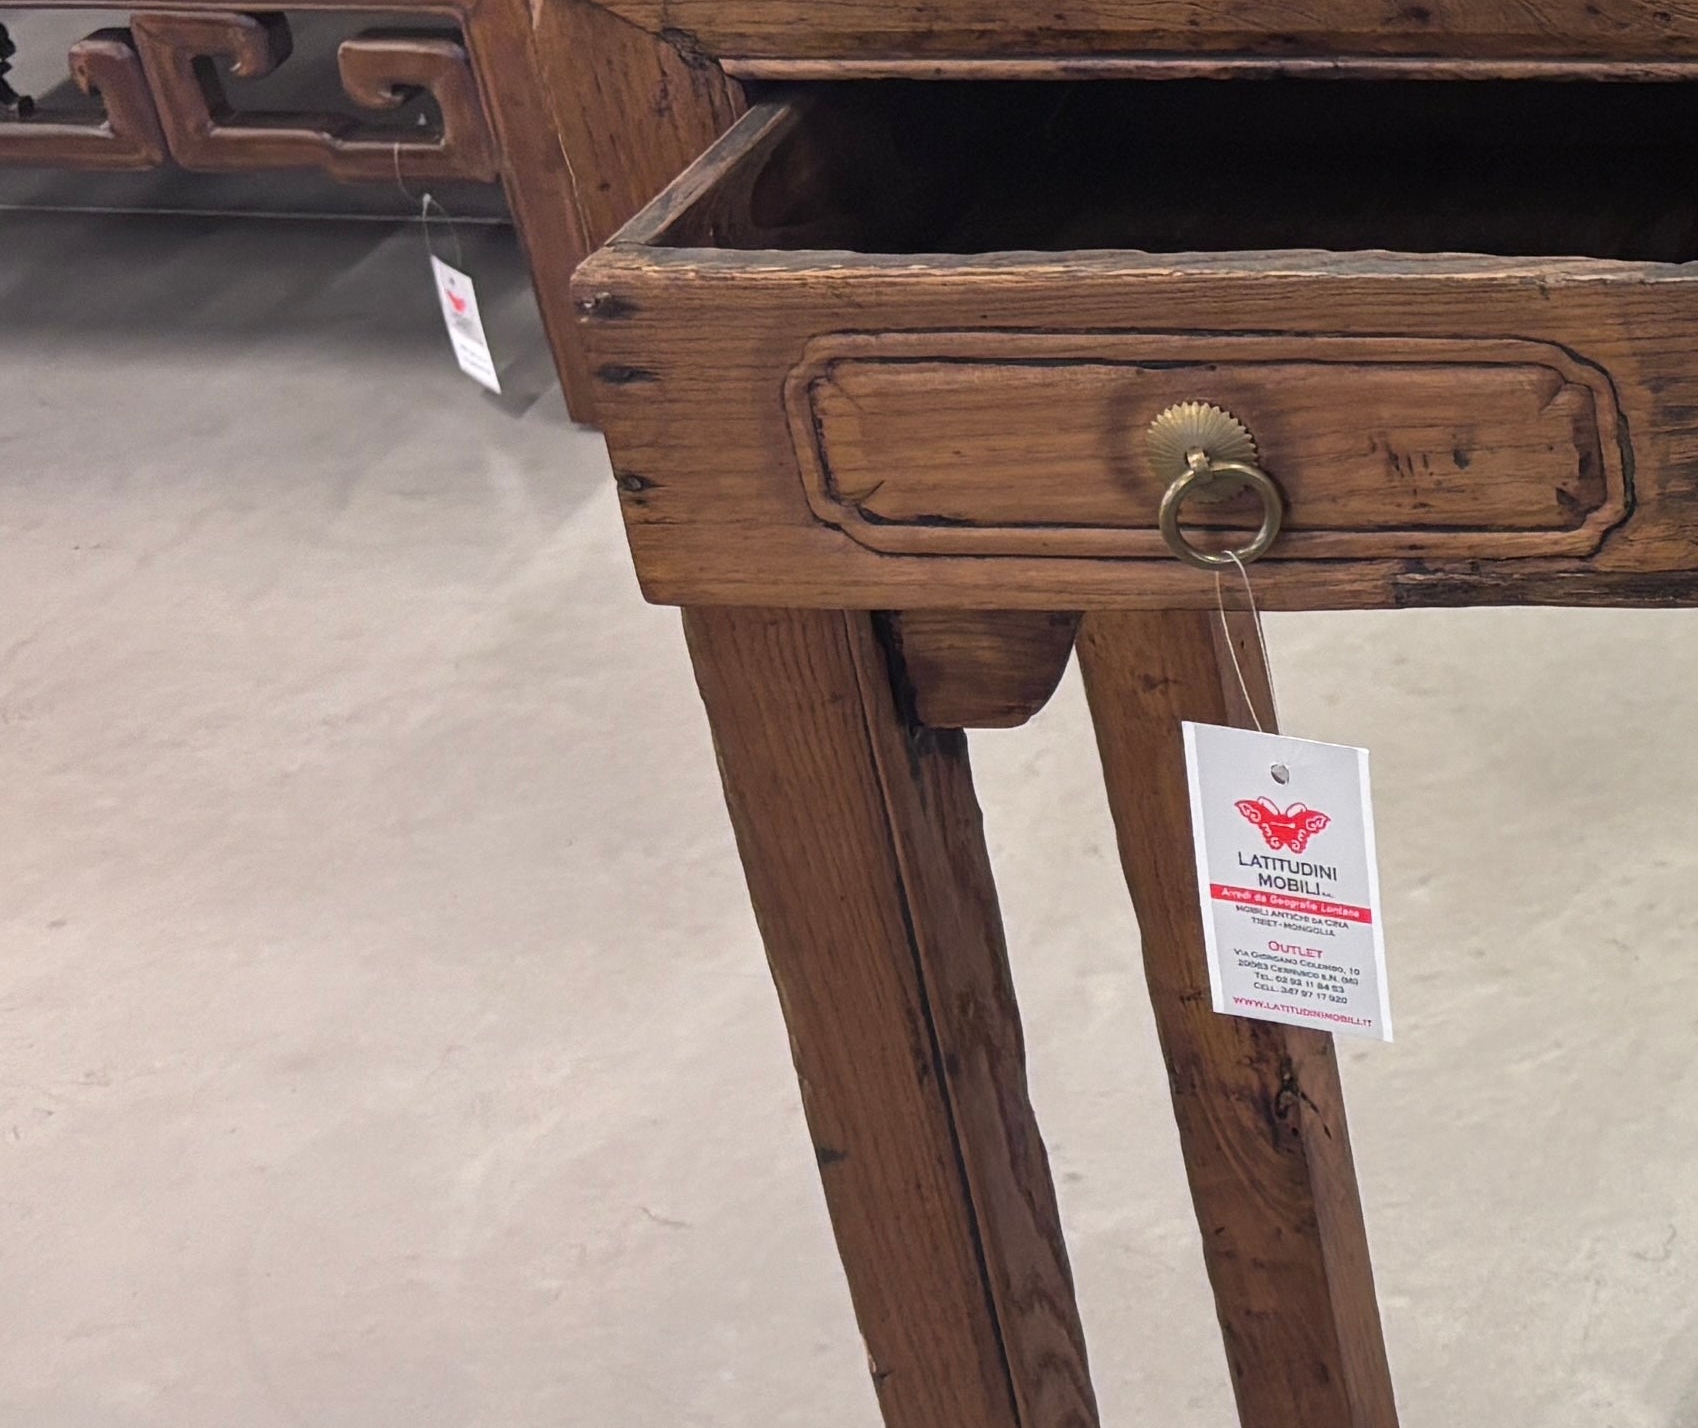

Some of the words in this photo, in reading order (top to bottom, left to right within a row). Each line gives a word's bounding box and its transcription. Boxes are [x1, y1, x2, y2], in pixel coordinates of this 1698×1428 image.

[1238, 851, 1337, 881] LATITUDINI
[1258, 873, 1320, 896] MOBILI
[1270, 910, 1310, 923] ANTICHI
[1311, 917, 1324, 926] DA
[1324, 918, 1349, 930] CINA
[1283, 922, 1336, 937] MONGOLIA
[1268, 940, 1323, 959] OUTLET
[1233, 948, 1249, 957] VIA
[1349, 967, 1360, 976] 10
[1306, 980, 1314, 988] 11
